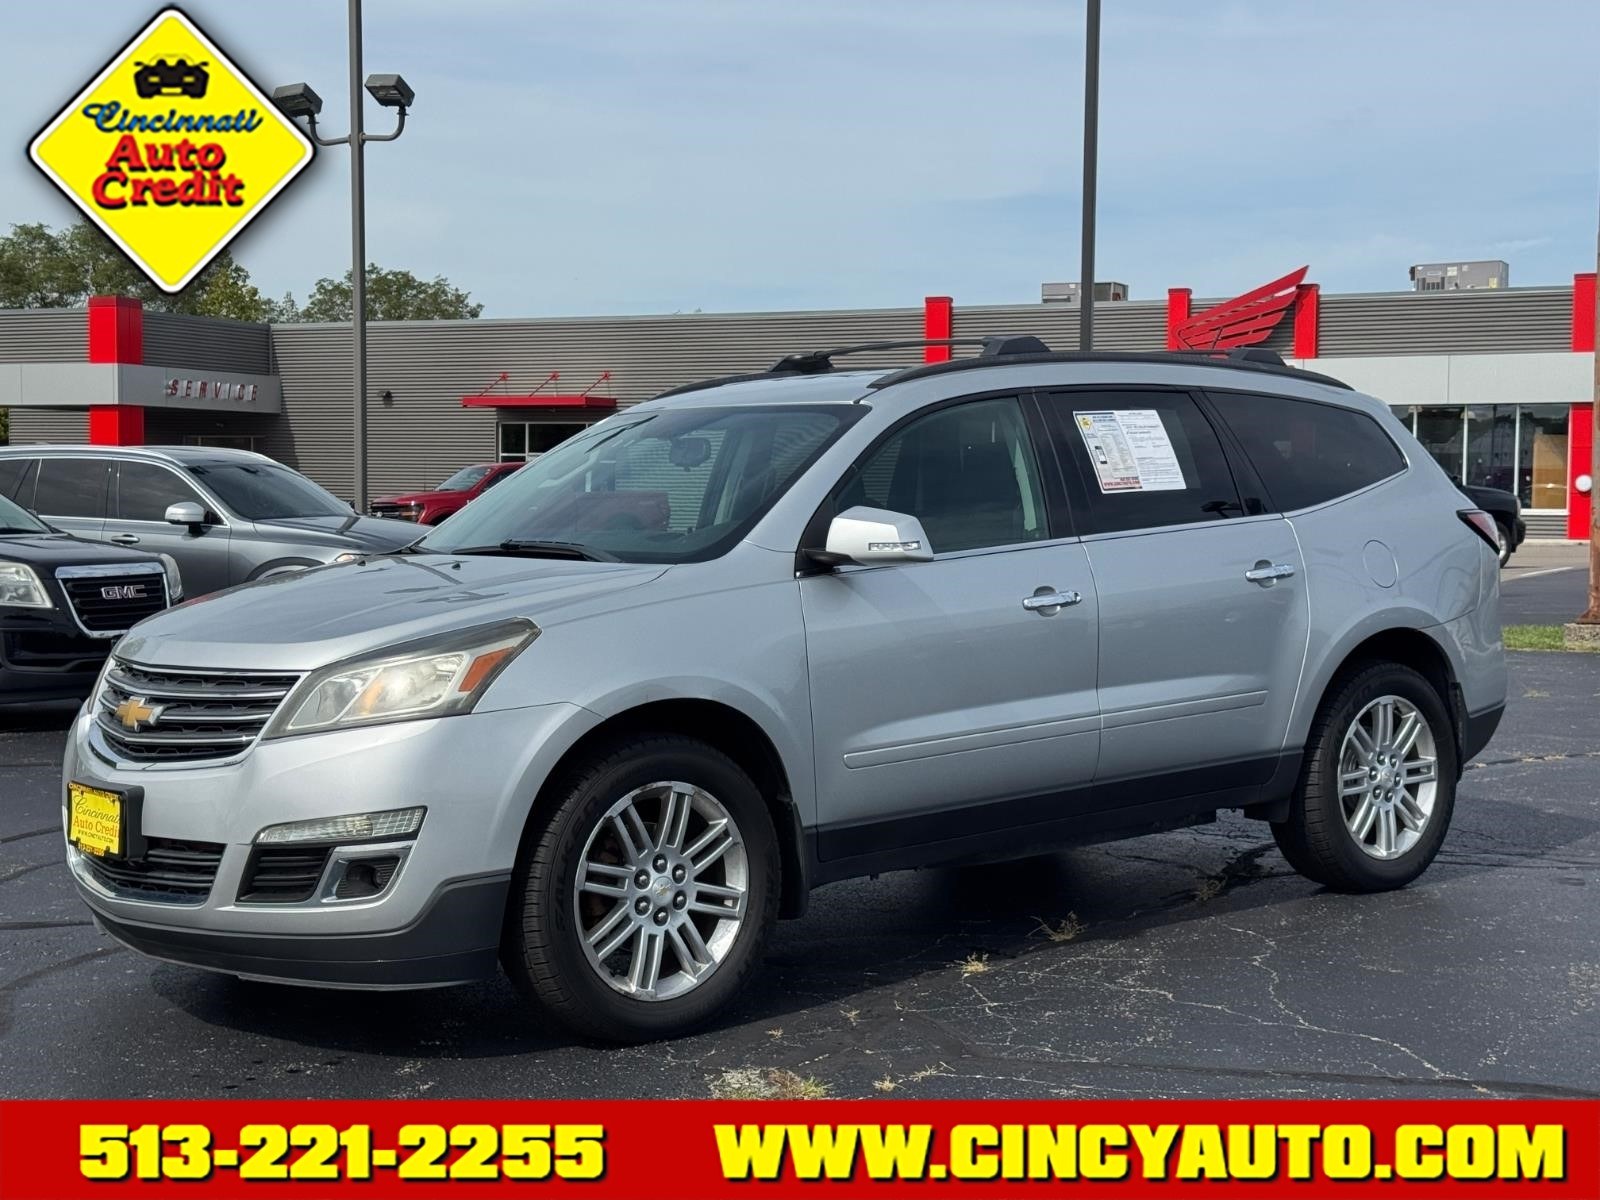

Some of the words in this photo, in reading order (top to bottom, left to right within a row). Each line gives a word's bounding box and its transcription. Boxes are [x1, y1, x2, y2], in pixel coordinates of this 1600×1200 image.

[166, 379, 258, 401] SERVICE
[101, 585, 147, 600] GMC
[73, 815, 94, 831] Auto
[95, 821, 120, 838] Credi
